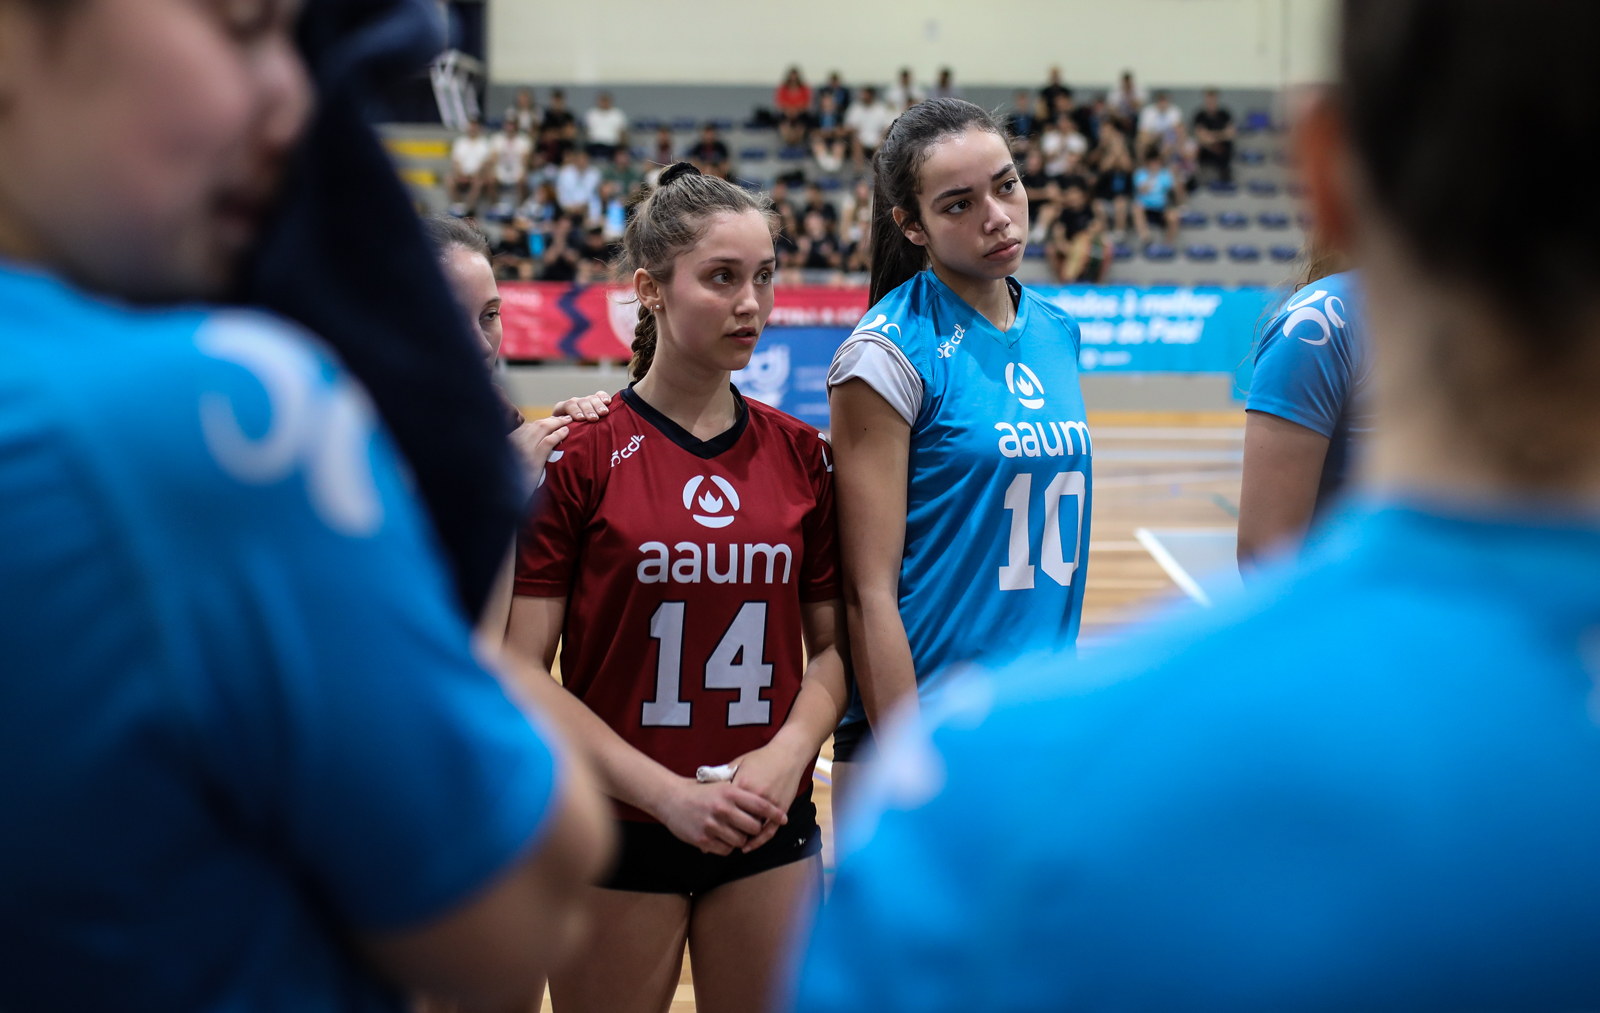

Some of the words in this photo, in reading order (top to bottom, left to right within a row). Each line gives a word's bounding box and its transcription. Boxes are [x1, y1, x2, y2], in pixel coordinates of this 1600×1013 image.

[994, 420, 1094, 458] aaum
[636, 541, 793, 585] aaum
[998, 470, 1086, 591] 10
[640, 600, 775, 729] 14
